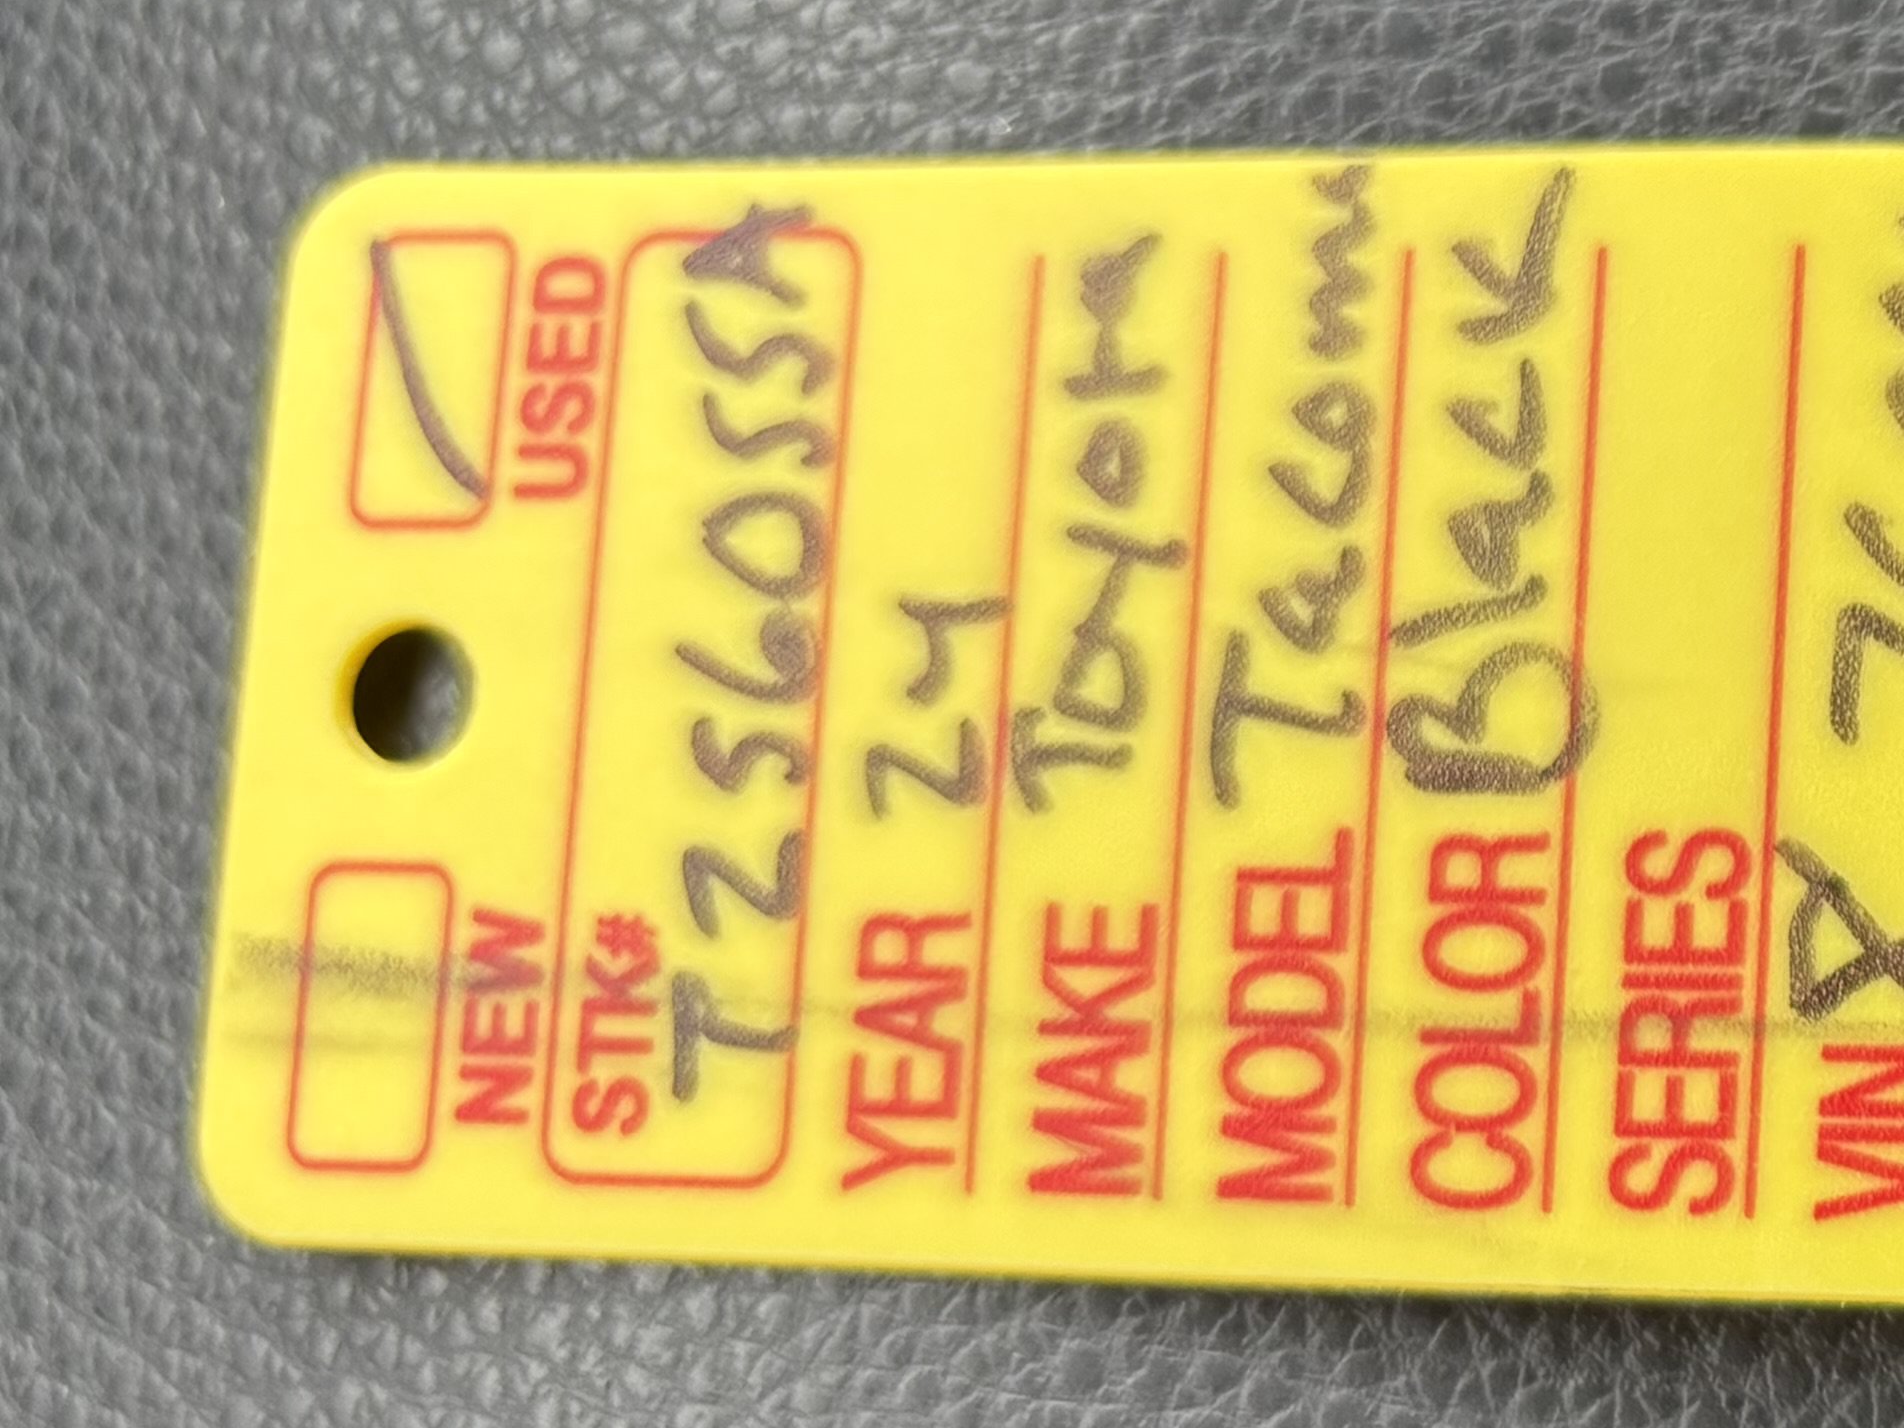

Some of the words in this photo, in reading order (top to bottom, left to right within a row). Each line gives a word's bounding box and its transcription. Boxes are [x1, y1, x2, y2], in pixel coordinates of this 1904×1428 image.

[513, 255, 607, 502] USED
[1012, 232, 1189, 813] Toyota
[1386, 165, 1602, 795] Black
[866, 594, 1012, 821] 24
[454, 906, 547, 1125] NEW
[572, 913, 661, 1138] STK#
[840, 912, 972, 1193] YEAR
[1025, 899, 1161, 1199] MAKE
[1215, 825, 1357, 1205] MODEL
[1409, 829, 1552, 1214] COLOR
[1607, 827, 1754, 1218] SERIES
